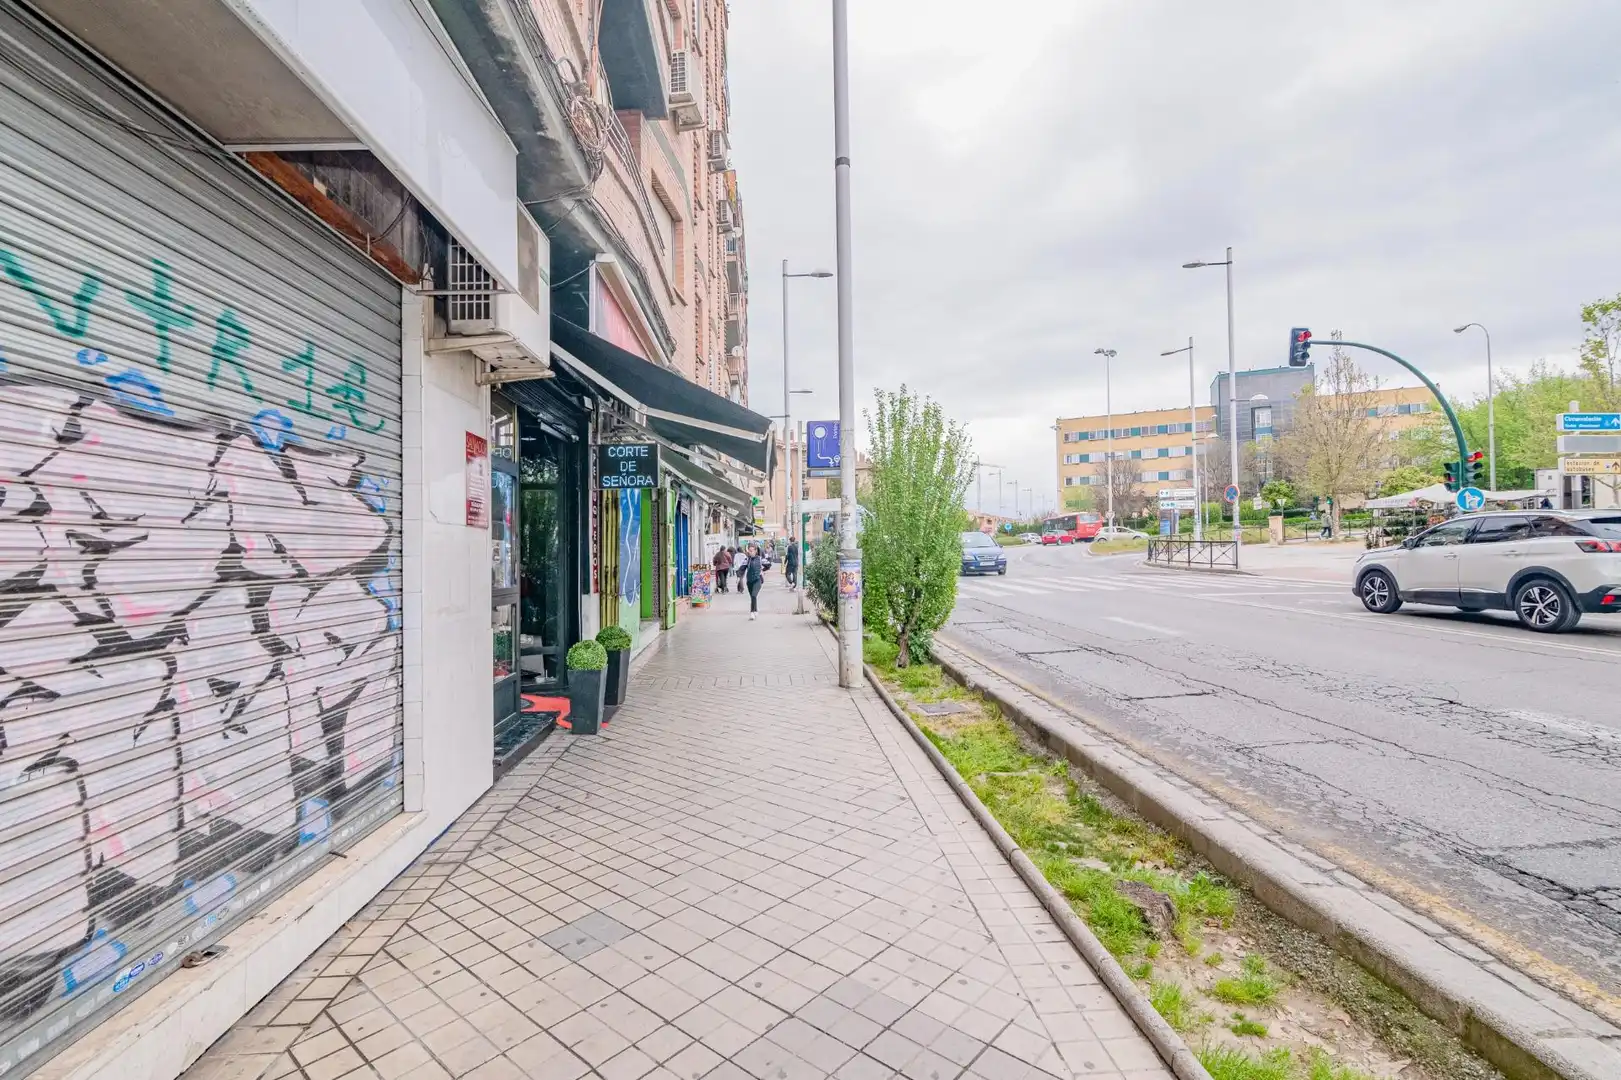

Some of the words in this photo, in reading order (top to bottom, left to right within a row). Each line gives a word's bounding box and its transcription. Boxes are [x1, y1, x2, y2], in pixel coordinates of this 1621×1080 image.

[608, 446, 648, 458] CORTE
[620, 461, 636, 472] DE
[602, 473, 654, 487] SEÑORA
